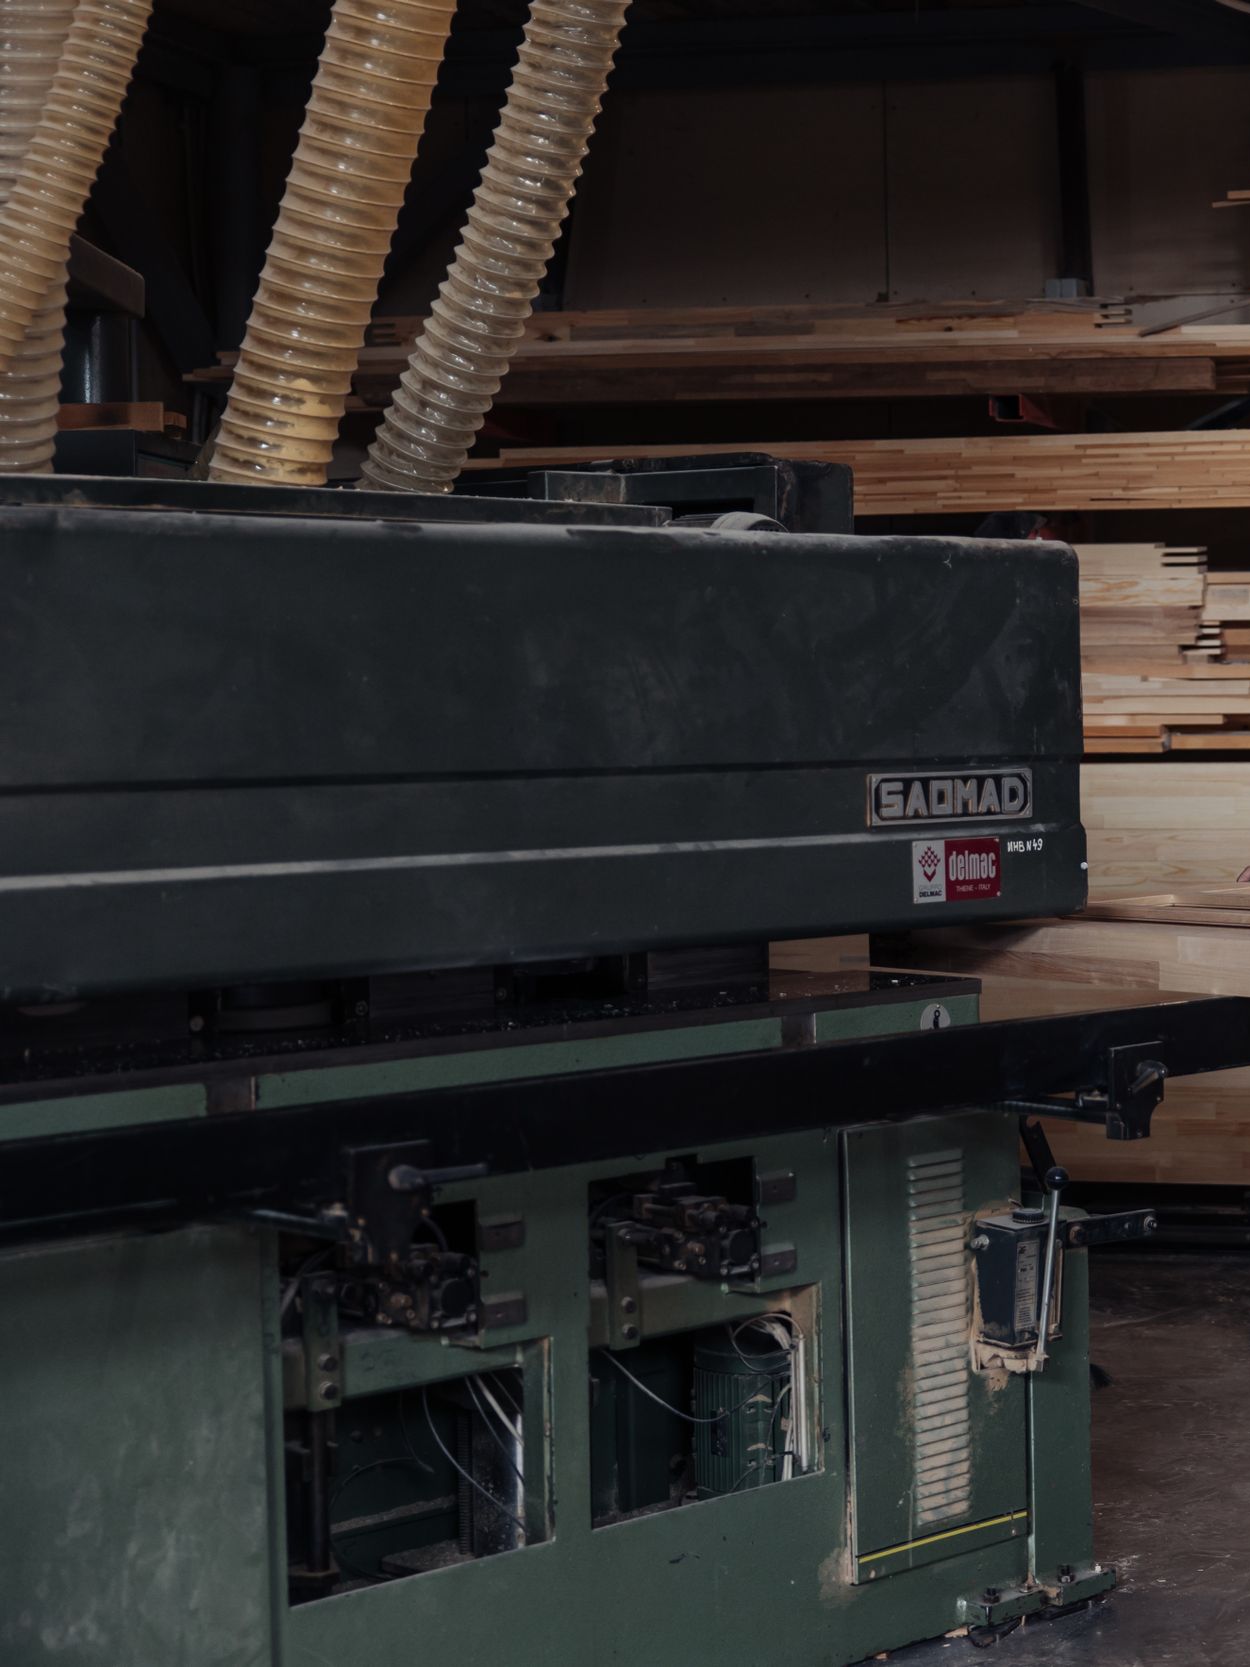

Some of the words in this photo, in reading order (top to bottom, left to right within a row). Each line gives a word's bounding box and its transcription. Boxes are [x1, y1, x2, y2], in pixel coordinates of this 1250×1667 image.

[879, 776, 1025, 817] SAOMAD
[1033, 838, 1043, 851] 49
[949, 851, 996, 881] delmac
[919, 890, 942, 898] DELMAC
